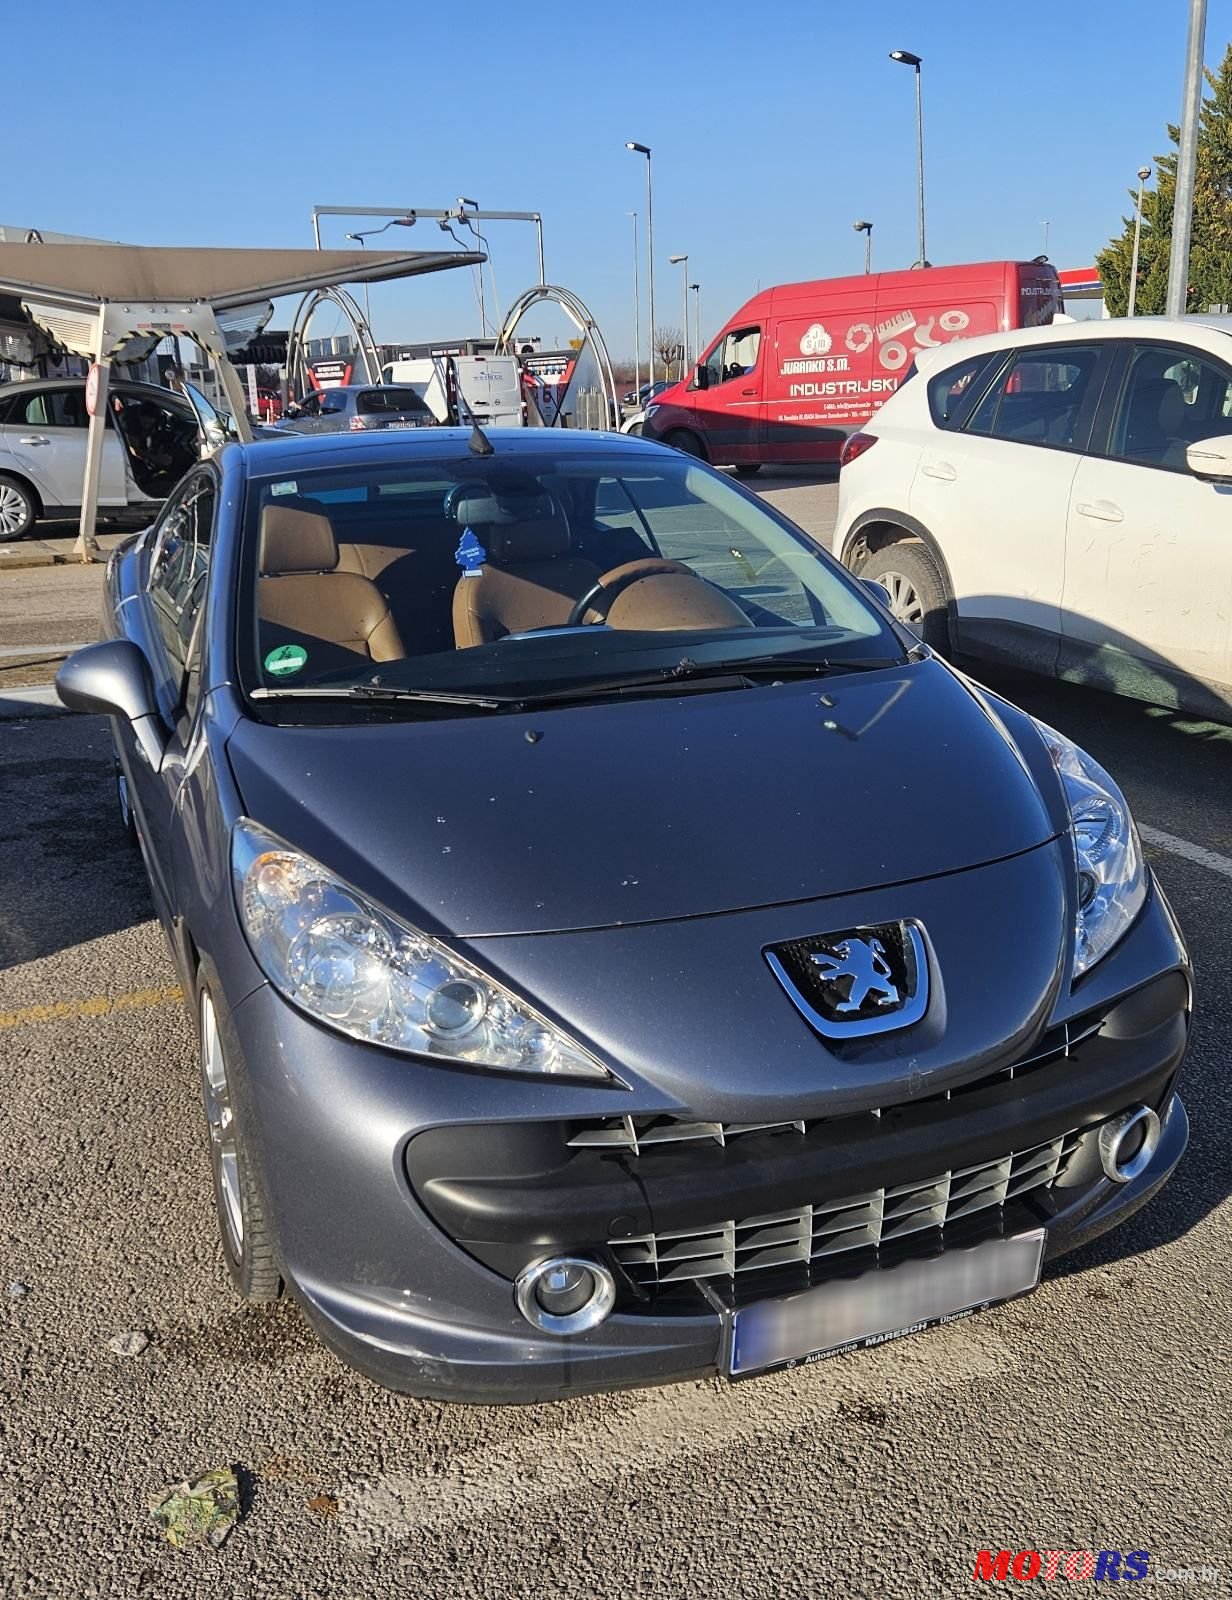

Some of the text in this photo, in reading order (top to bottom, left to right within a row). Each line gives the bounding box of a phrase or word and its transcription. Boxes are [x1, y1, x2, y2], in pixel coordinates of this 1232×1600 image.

[780, 357, 851, 375] JURANKO S.M.
[789, 378, 898, 396] INDUSTRIJSKI
[804, 1342, 858, 1364] Autoservice
[865, 1322, 928, 1347] MARESCH
